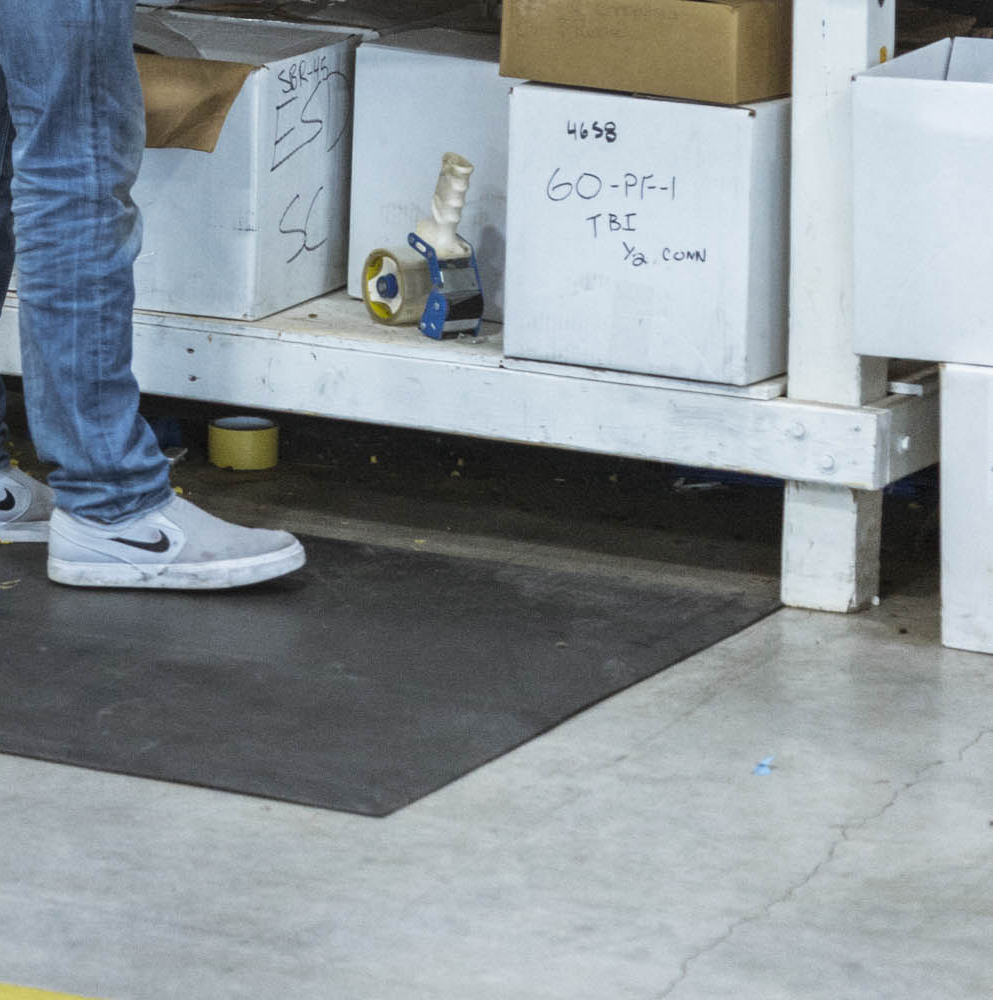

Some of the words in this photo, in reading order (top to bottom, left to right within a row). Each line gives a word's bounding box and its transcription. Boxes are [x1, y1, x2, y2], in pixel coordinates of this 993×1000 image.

[566, 119, 617, 143] 4658
[585, 213, 637, 239] TBI
[662, 247, 707, 263] CONN
